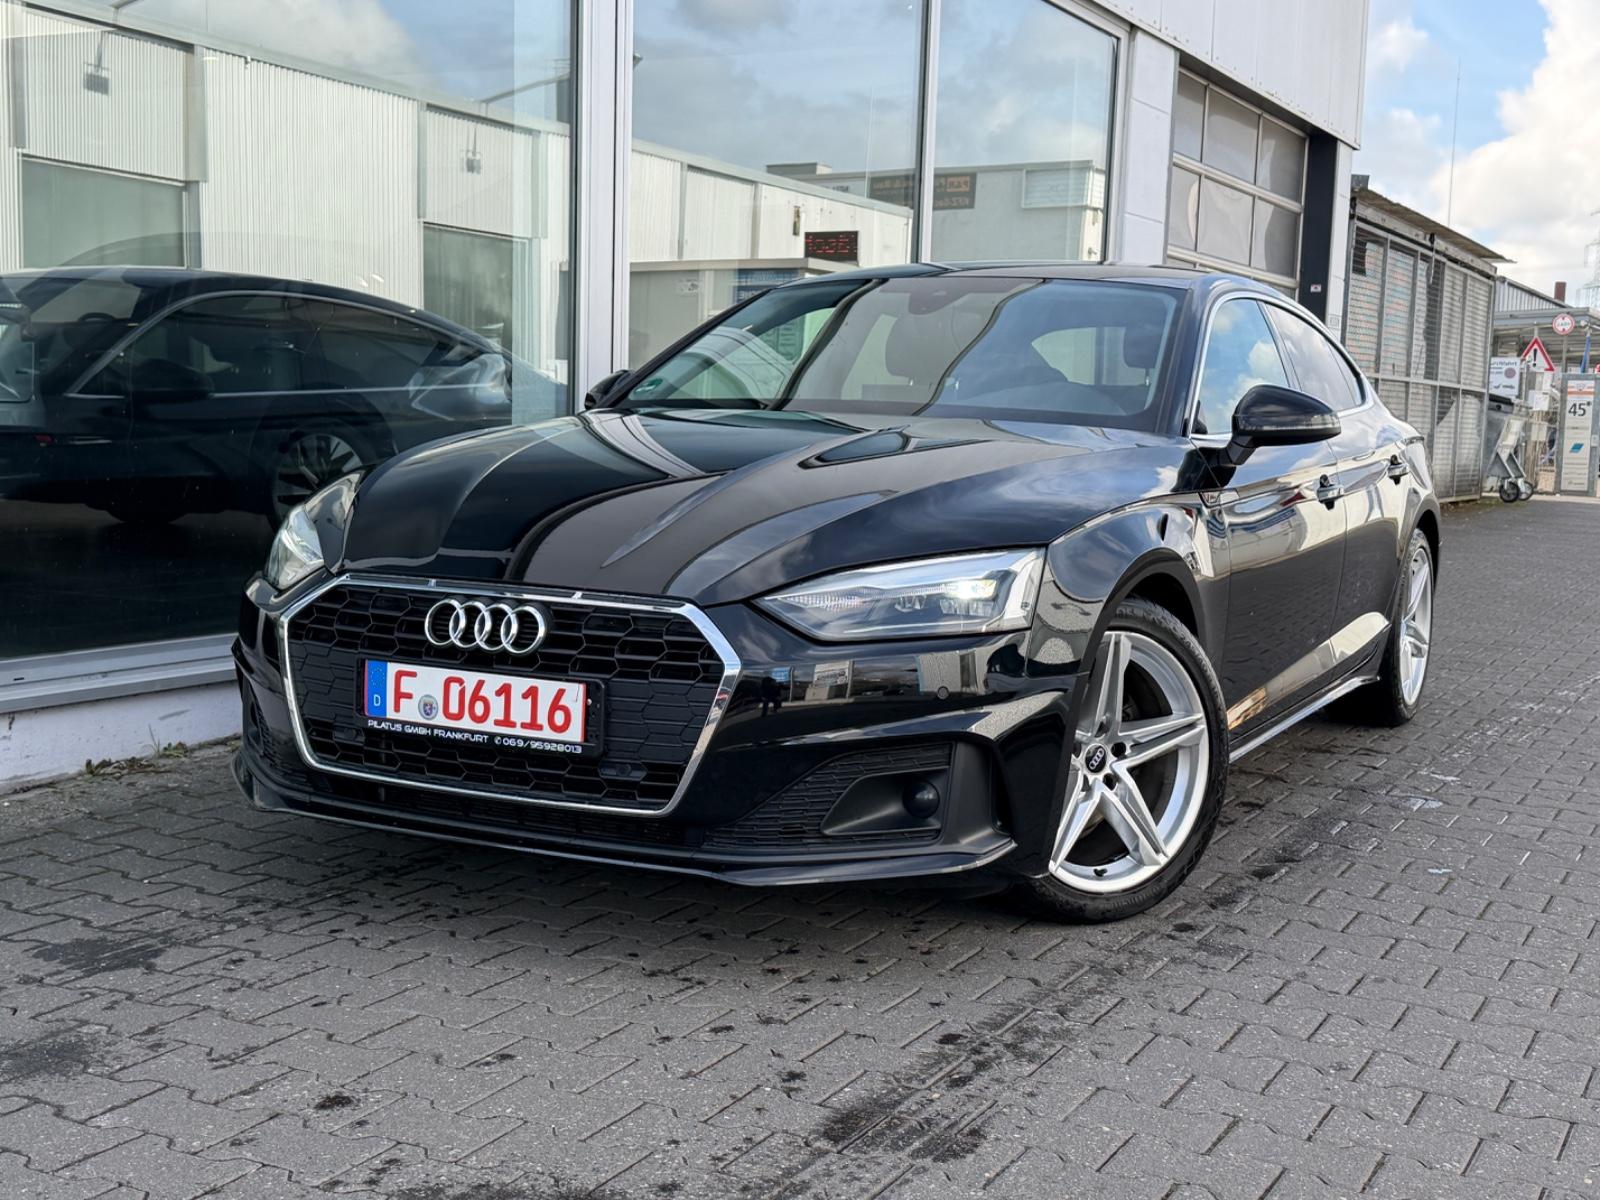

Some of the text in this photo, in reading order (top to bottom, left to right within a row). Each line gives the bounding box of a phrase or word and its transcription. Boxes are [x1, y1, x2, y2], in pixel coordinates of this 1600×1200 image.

[373, 694, 381, 707] D
[394, 669, 572, 734] F 06116
[367, 719, 402, 732] PILATUS
[433, 729, 489, 743] FRANKFURT
